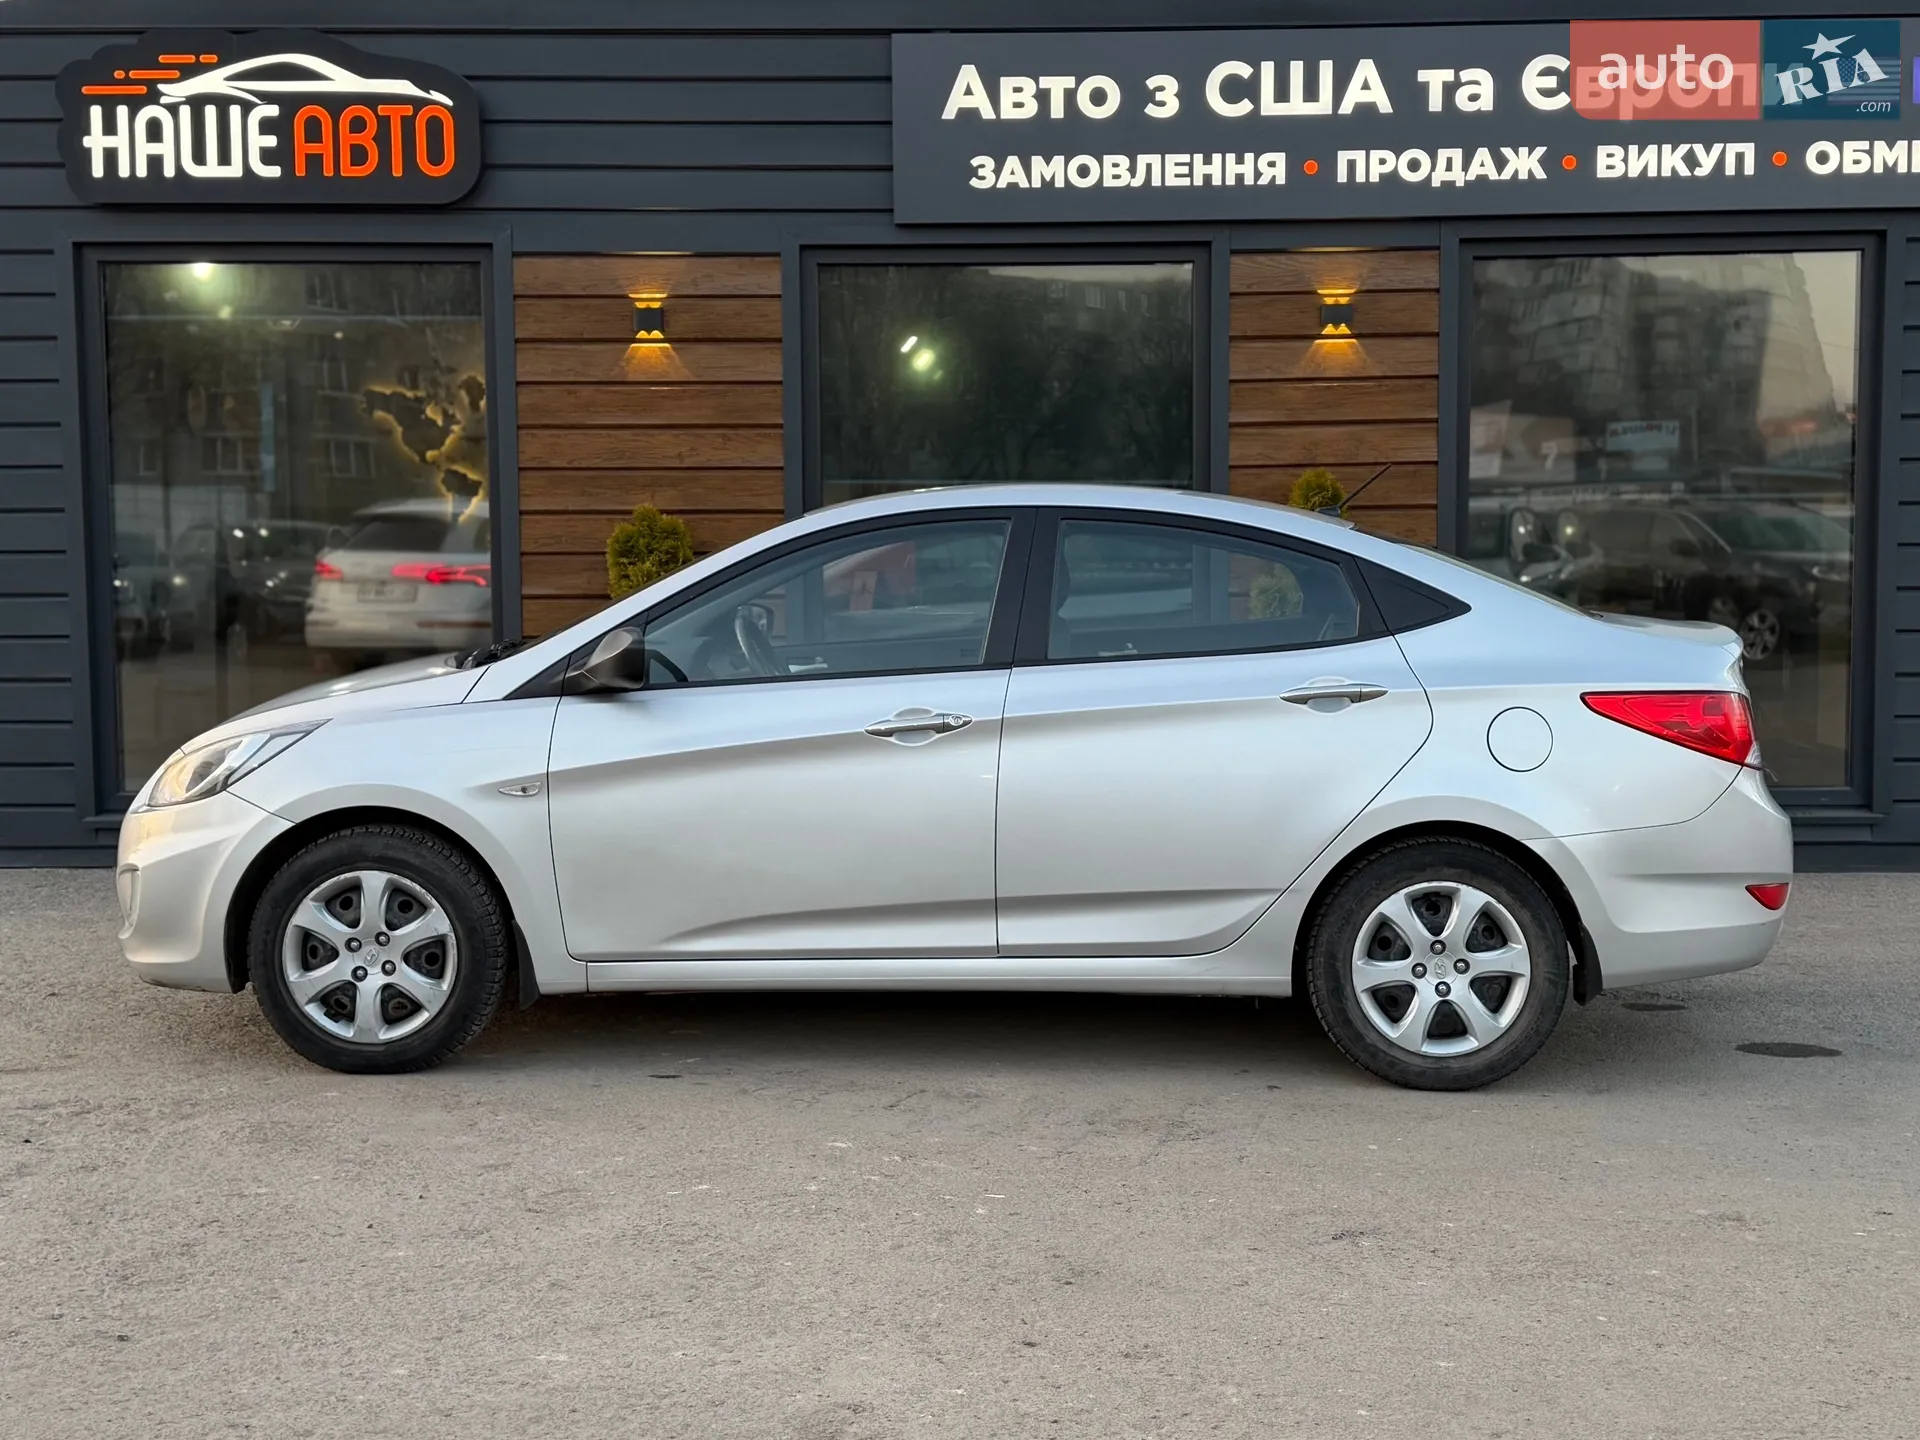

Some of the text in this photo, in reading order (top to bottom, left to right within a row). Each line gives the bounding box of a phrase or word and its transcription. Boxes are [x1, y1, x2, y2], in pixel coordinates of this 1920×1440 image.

[941, 64, 1121, 120] Авто
[1143, 74, 1180, 119] з
[1205, 58, 1394, 118] США
[1417, 68, 1496, 115] та
[82, 104, 455, 178] НАШЕ АВТО
[968, 152, 1286, 189] ЗАМОВЛЕННЯ
[1336, 146, 1548, 188] ПРОДАЖ
[1596, 142, 1755, 179] ВИКУП
